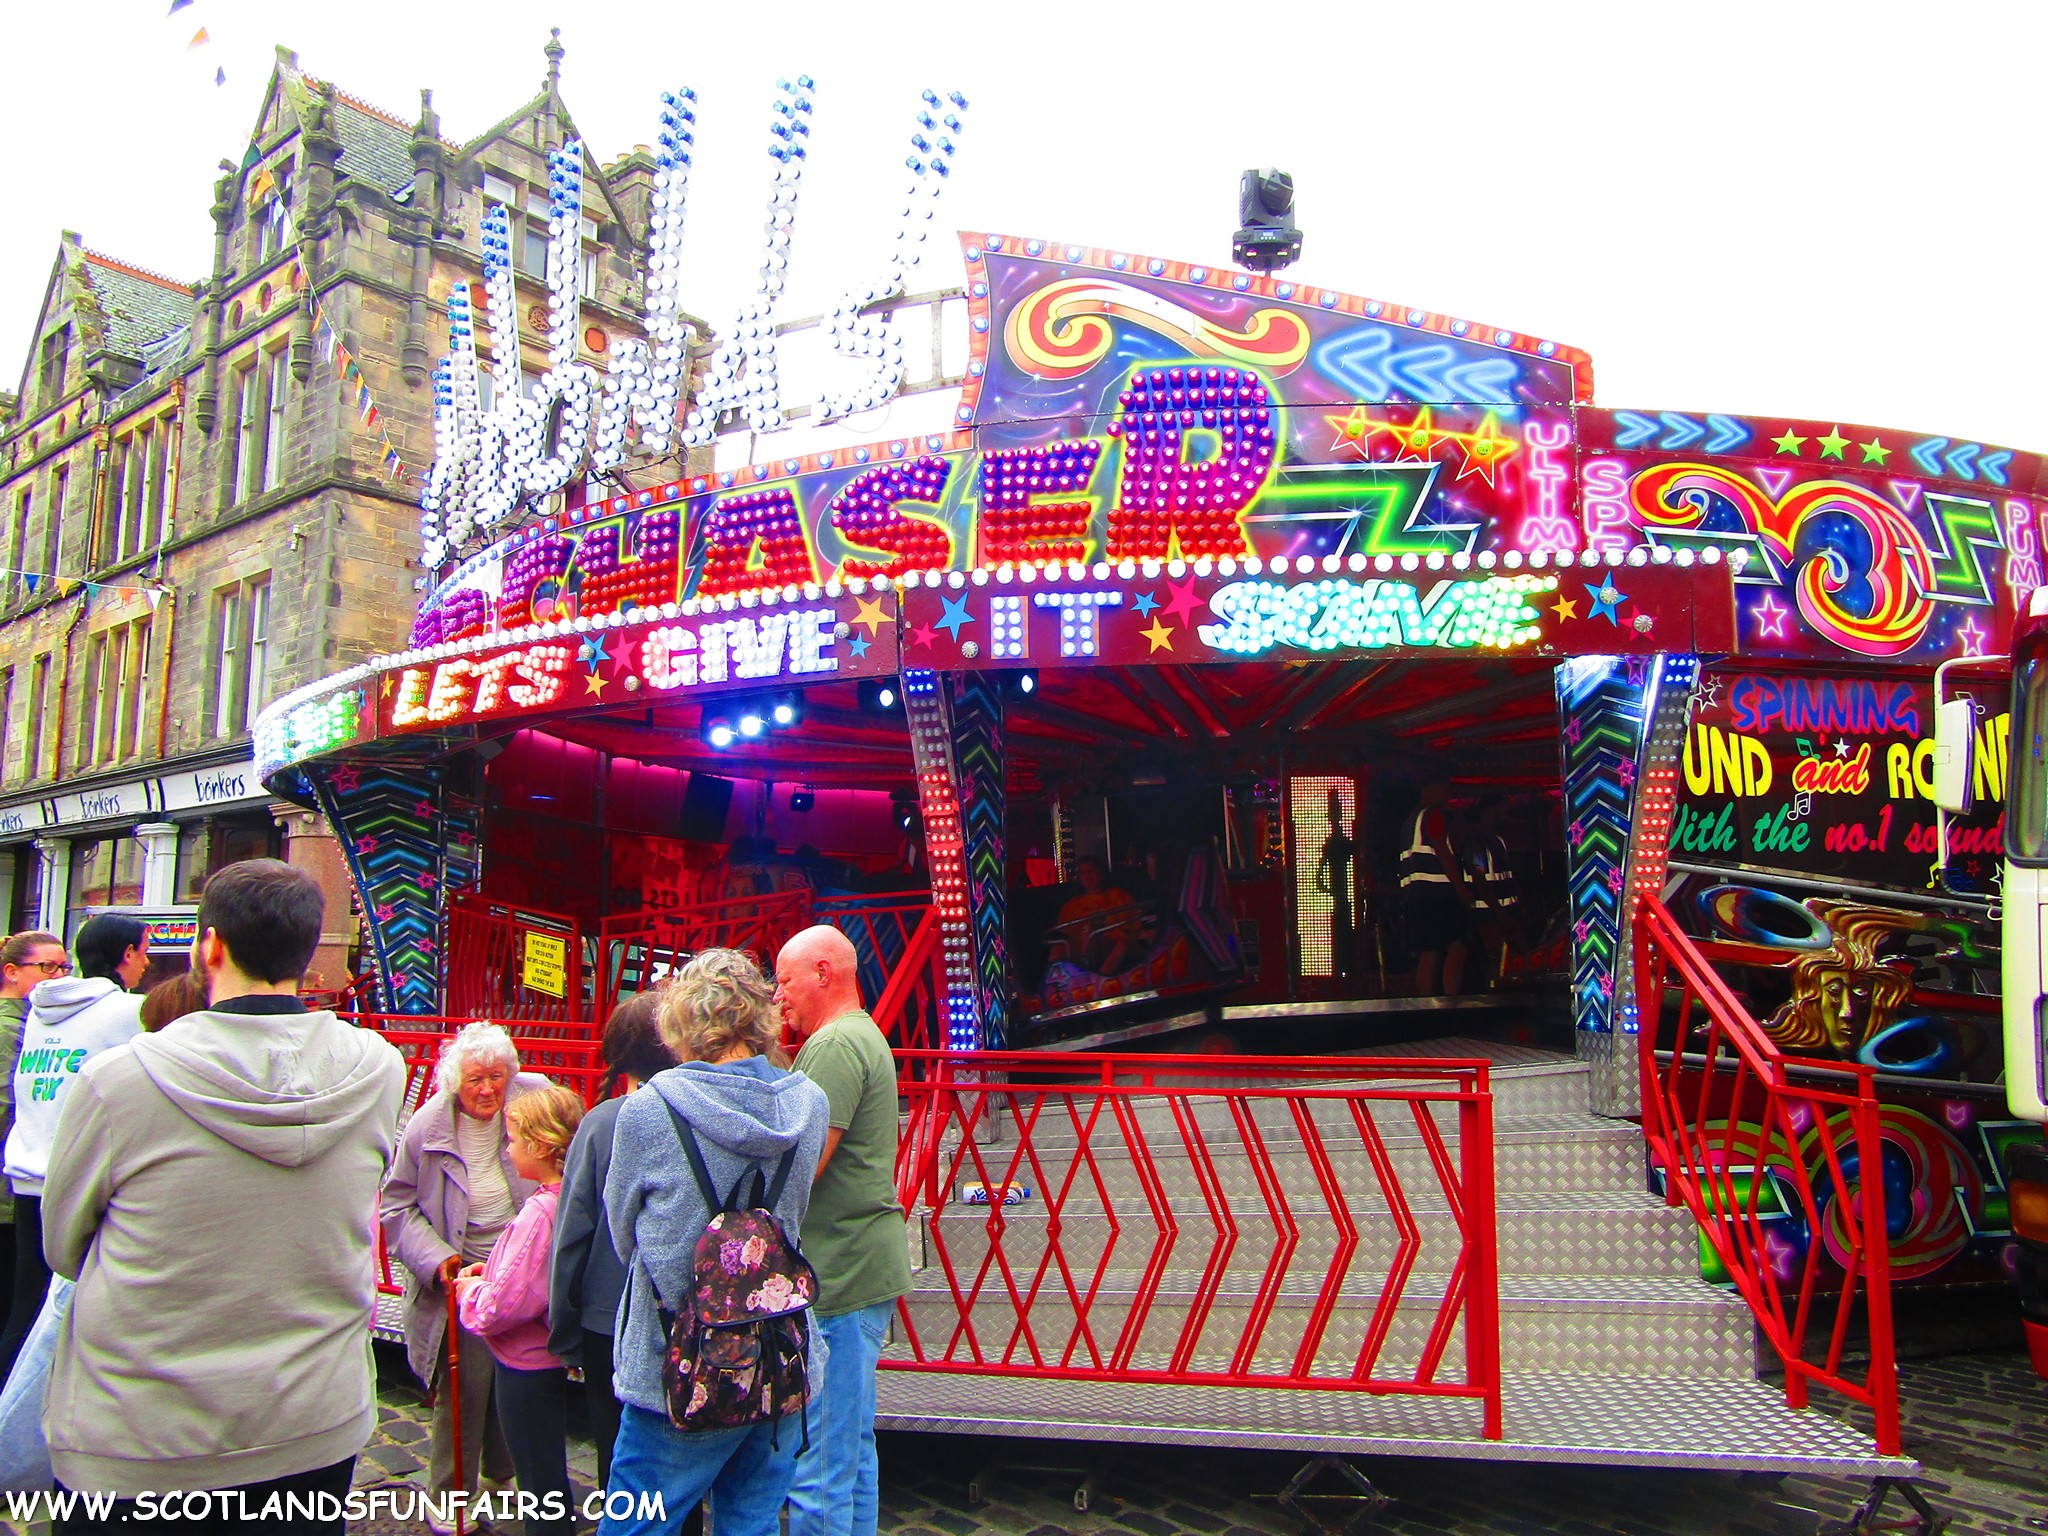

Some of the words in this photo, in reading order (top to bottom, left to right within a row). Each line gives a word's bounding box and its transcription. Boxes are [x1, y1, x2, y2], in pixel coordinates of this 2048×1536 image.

[502, 360, 1284, 628] CHASER
[1519, 422, 1577, 551] ULTIM
[391, 645, 571, 728] LETS
[641, 609, 838, 690] GIVE
[990, 591, 1124, 658] IT
[1196, 574, 1559, 655] SOME
[1729, 676, 1920, 739] SPINNING
[1792, 742, 1871, 795] and
[1752, 802, 1811, 853] the
[20, 1048, 88, 1074] WHITE
